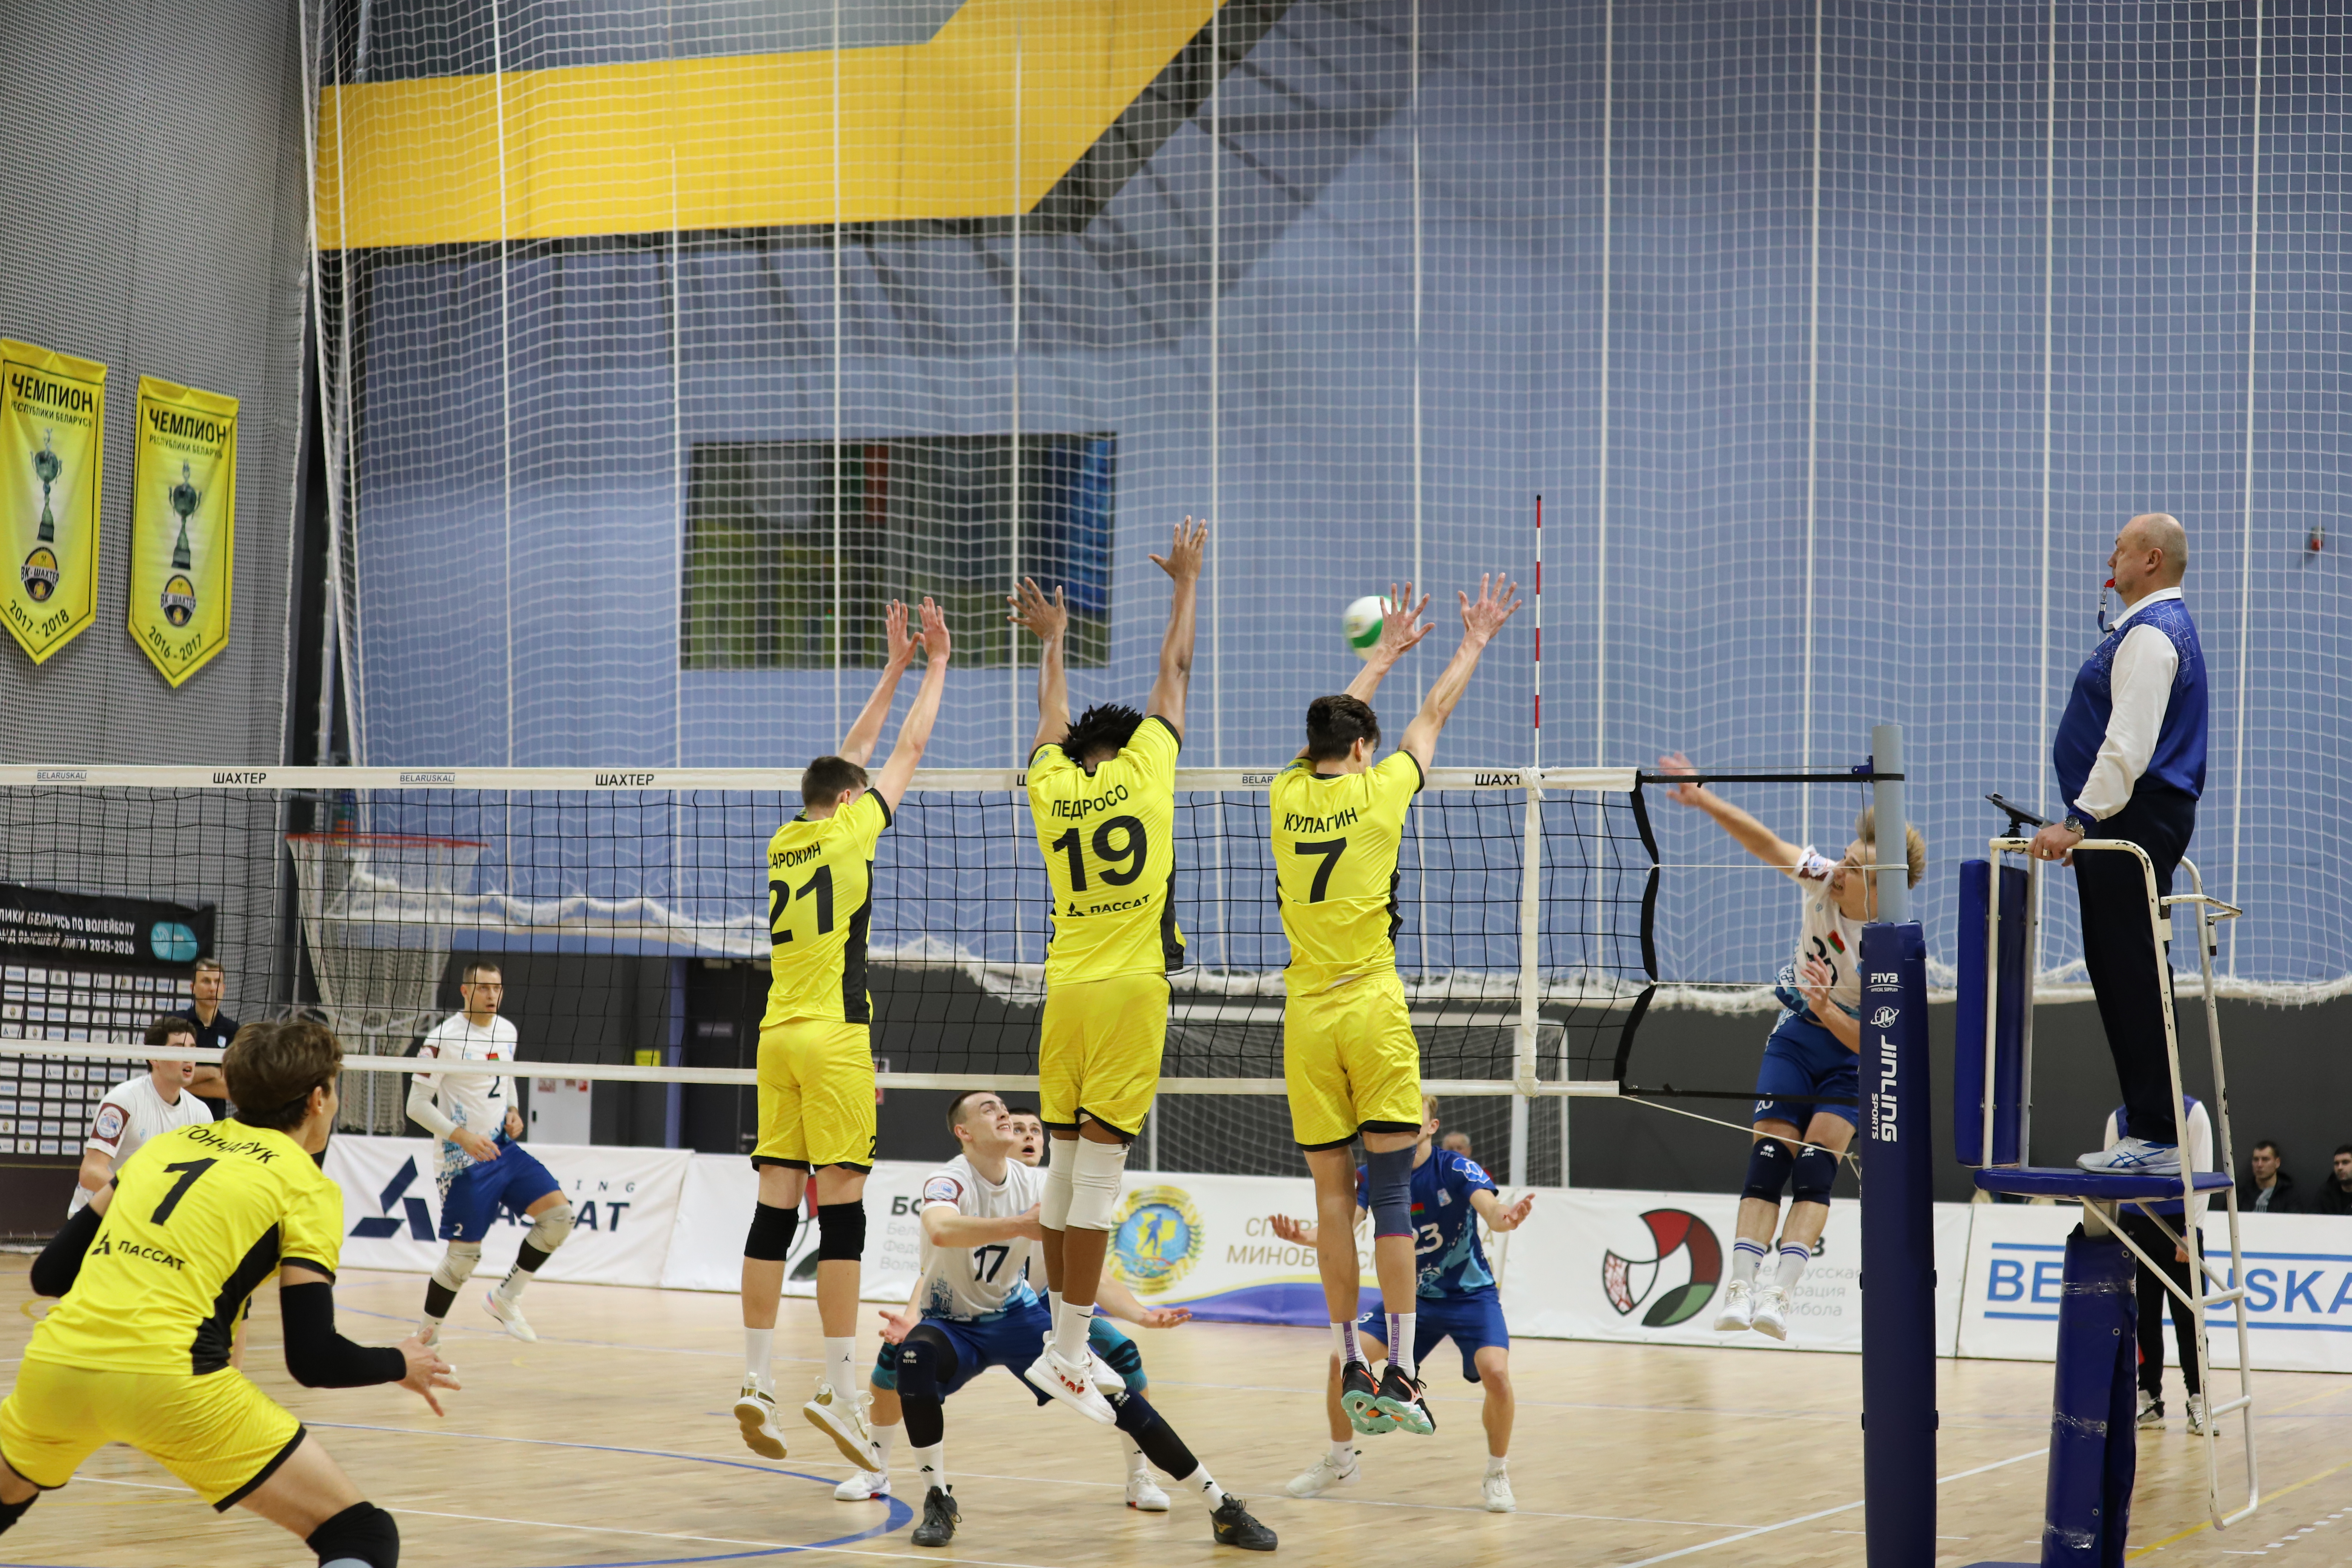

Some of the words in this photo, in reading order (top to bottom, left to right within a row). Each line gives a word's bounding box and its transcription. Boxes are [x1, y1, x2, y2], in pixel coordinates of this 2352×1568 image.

[12, 373, 93, 413] ЧЕМПИОН
[56, 412, 92, 427] БЕЛАРУСЬ
[150, 408, 226, 444] ЧЕМПИОН
[21, 566, 29, 580] ВК
[34, 568, 59, 585] ШАХТЕР
[10, 599, 33, 632] 2017
[42, 609, 69, 637] 2018
[149, 626, 170, 658] 2016
[180, 632, 201, 661] 2017
[213, 773, 266, 784] ШАХТЕР
[596, 774, 654, 786] ШАХТЕР
[1475, 774, 1545, 786] ШАХТ
[1051, 784, 1129, 821] ПЕДРОСО
[1283, 807, 1358, 833] КУЛАГИН
[769, 841, 821, 870] АРОКИН
[1052, 815, 1147, 892] 19
[1295, 837, 1347, 903] 7
[769, 864, 834, 946] 21
[1090, 894, 1150, 914] ПАССАТ
[27, 911, 70, 930] БЕЛАРУСЬ
[72, 916, 83, 931] ПО
[85, 917, 135, 936] ВОЛЕЙБОЛУ
[18, 929, 61, 947] ВЫСШЕЙ
[61, 935, 86, 951] ЛИГИ
[89, 939, 135, 955] 2025-2026
[1871, 973, 1899, 983] FIVB
[1881, 1035, 1897, 1142] JINLING
[178, 1125, 280, 1164] ГОНЧАРУК
[868, 1135, 876, 1159] 2
[149, 1158, 219, 1226] 1
[453, 1223, 462, 1236] 2
[117, 1240, 185, 1271] ПАССАТ
[880, 1257, 920, 1271] Воле
[974, 1245, 1009, 1283] 17
[1358, 1312, 1374, 1323] 3
